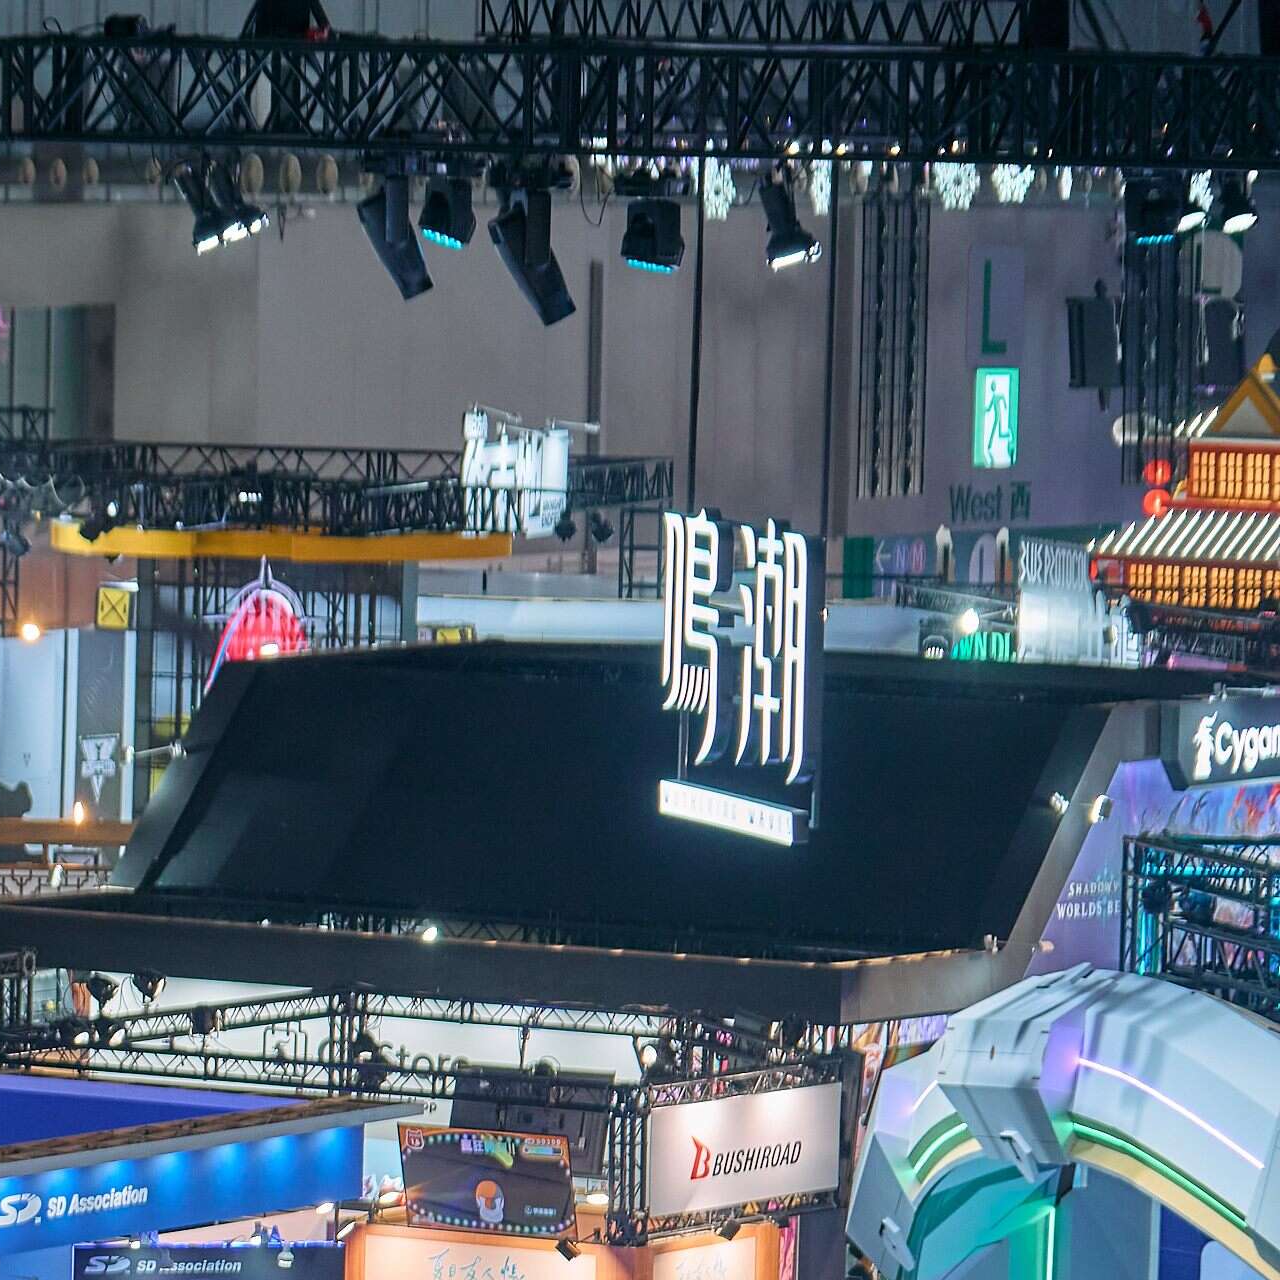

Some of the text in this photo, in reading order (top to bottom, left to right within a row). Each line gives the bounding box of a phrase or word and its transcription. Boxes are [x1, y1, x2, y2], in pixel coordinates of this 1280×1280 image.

[981, 258, 1008, 354] L
[948, 481, 1033, 522] West 西
[661, 508, 808, 786] 鳴潮
[1056, 901, 1103, 919] WORLDS
[712, 1140, 802, 1178] BUSHIROAD
[46, 1195, 67, 1217] SD
[69, 1185, 149, 1215] Association
[137, 1260, 157, 1272] SD
[159, 1259, 242, 1273] ssociation
